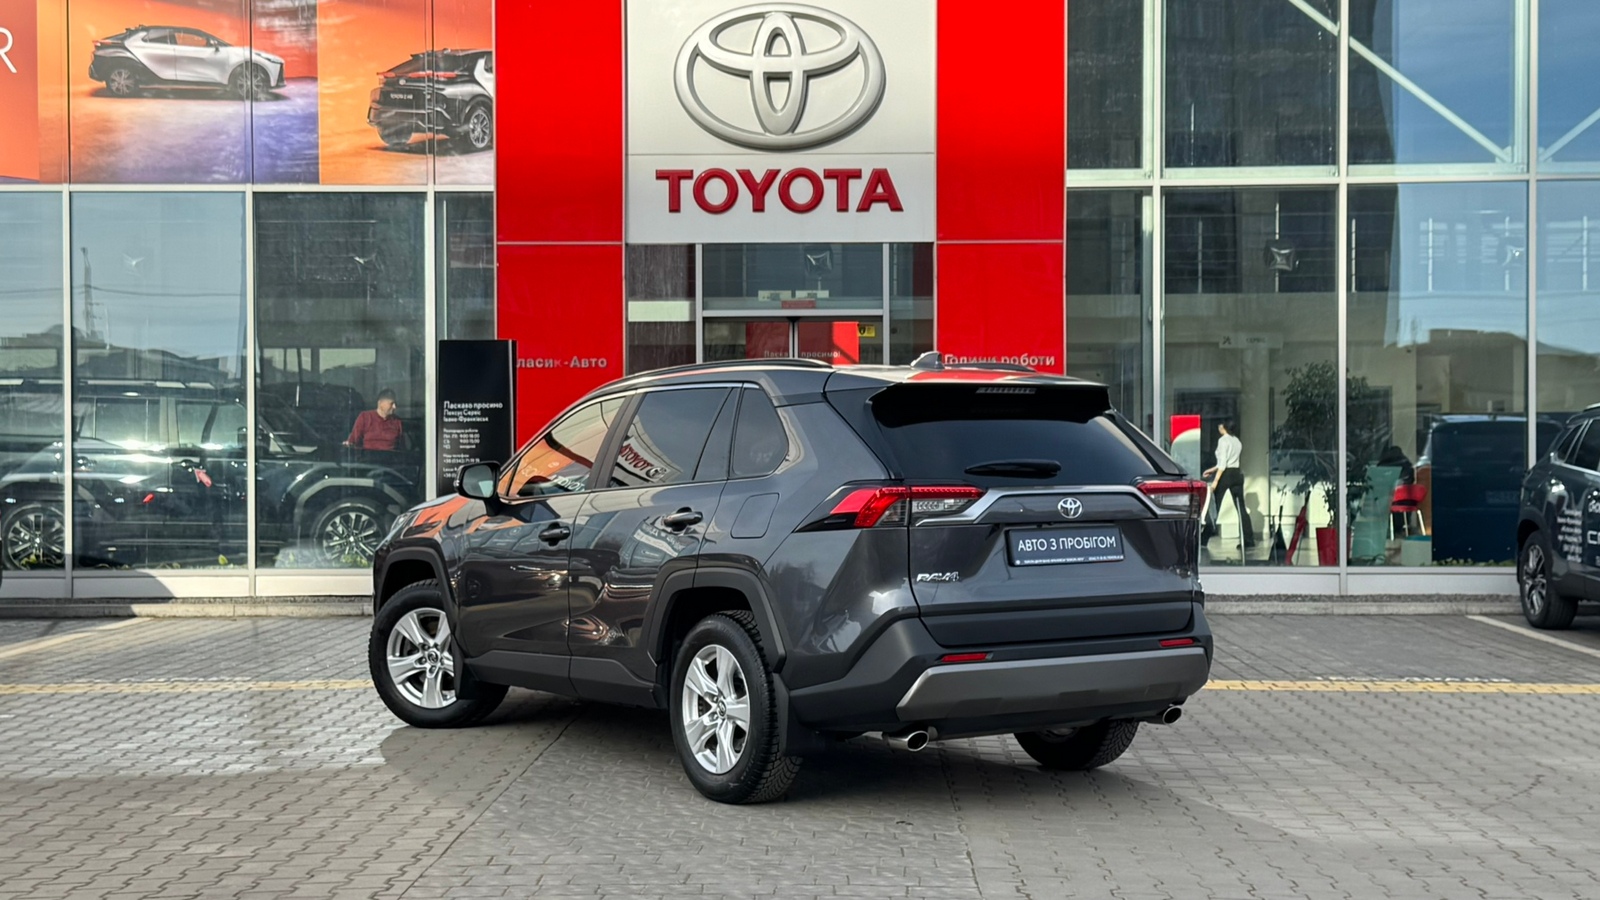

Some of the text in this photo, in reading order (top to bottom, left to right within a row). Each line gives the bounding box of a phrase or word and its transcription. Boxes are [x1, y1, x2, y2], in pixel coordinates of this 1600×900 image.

[655, 168, 904, 214] TOYOTA
[516, 356, 607, 368] ласик-Авто
[1001, 353, 1055, 366] роботи
[1018, 539, 1048, 551] АВТО
[1060, 536, 1117, 549] ПРОБІГОМ
